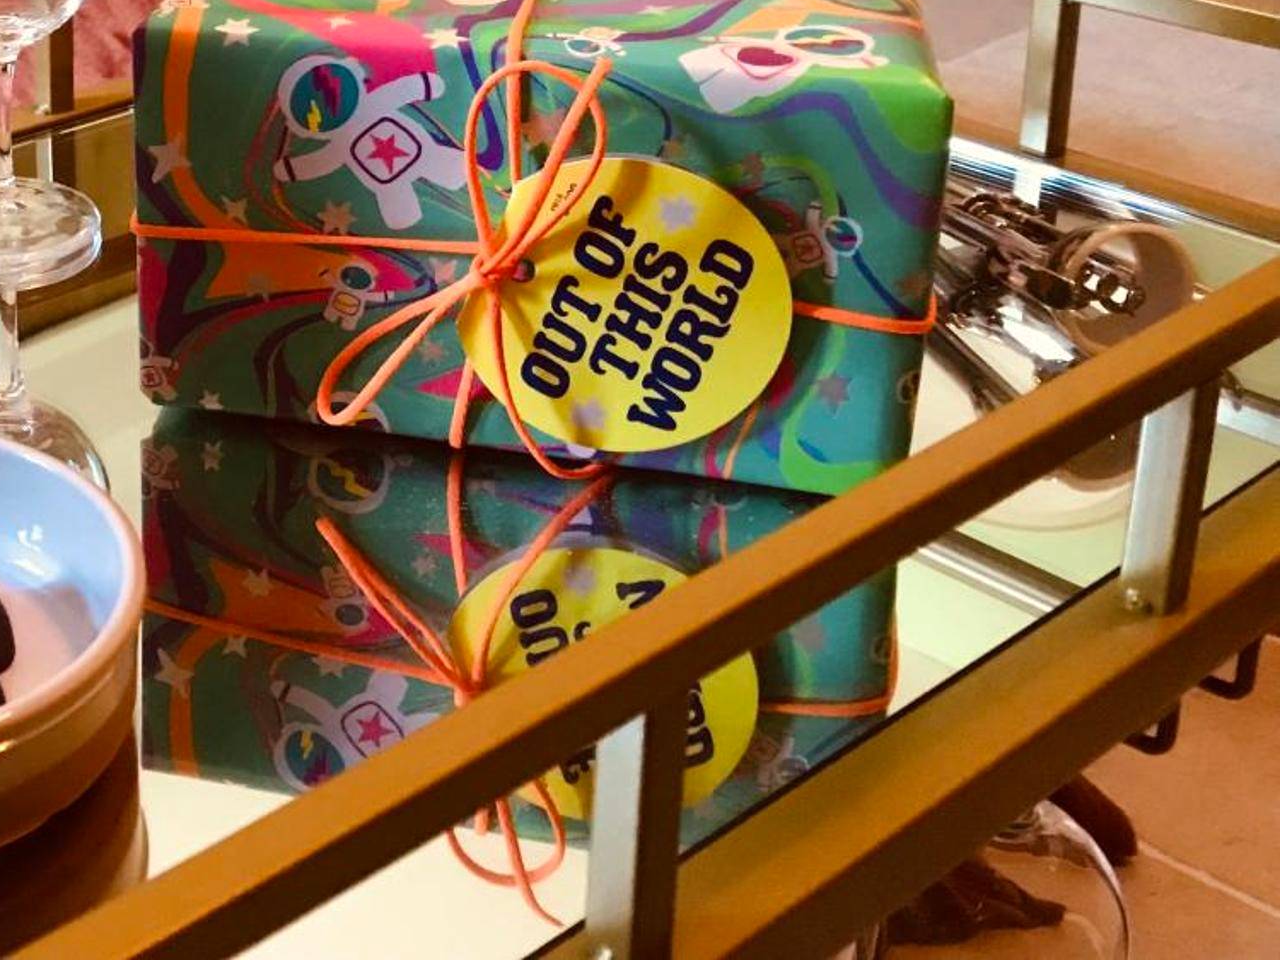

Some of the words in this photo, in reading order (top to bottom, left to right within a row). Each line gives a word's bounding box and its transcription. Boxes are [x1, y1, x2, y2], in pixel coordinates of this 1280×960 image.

[520, 275, 602, 399] OUT
[573, 194, 638, 280] OF
[589, 242, 689, 380] THIS
[626, 239, 756, 432] WORLD
